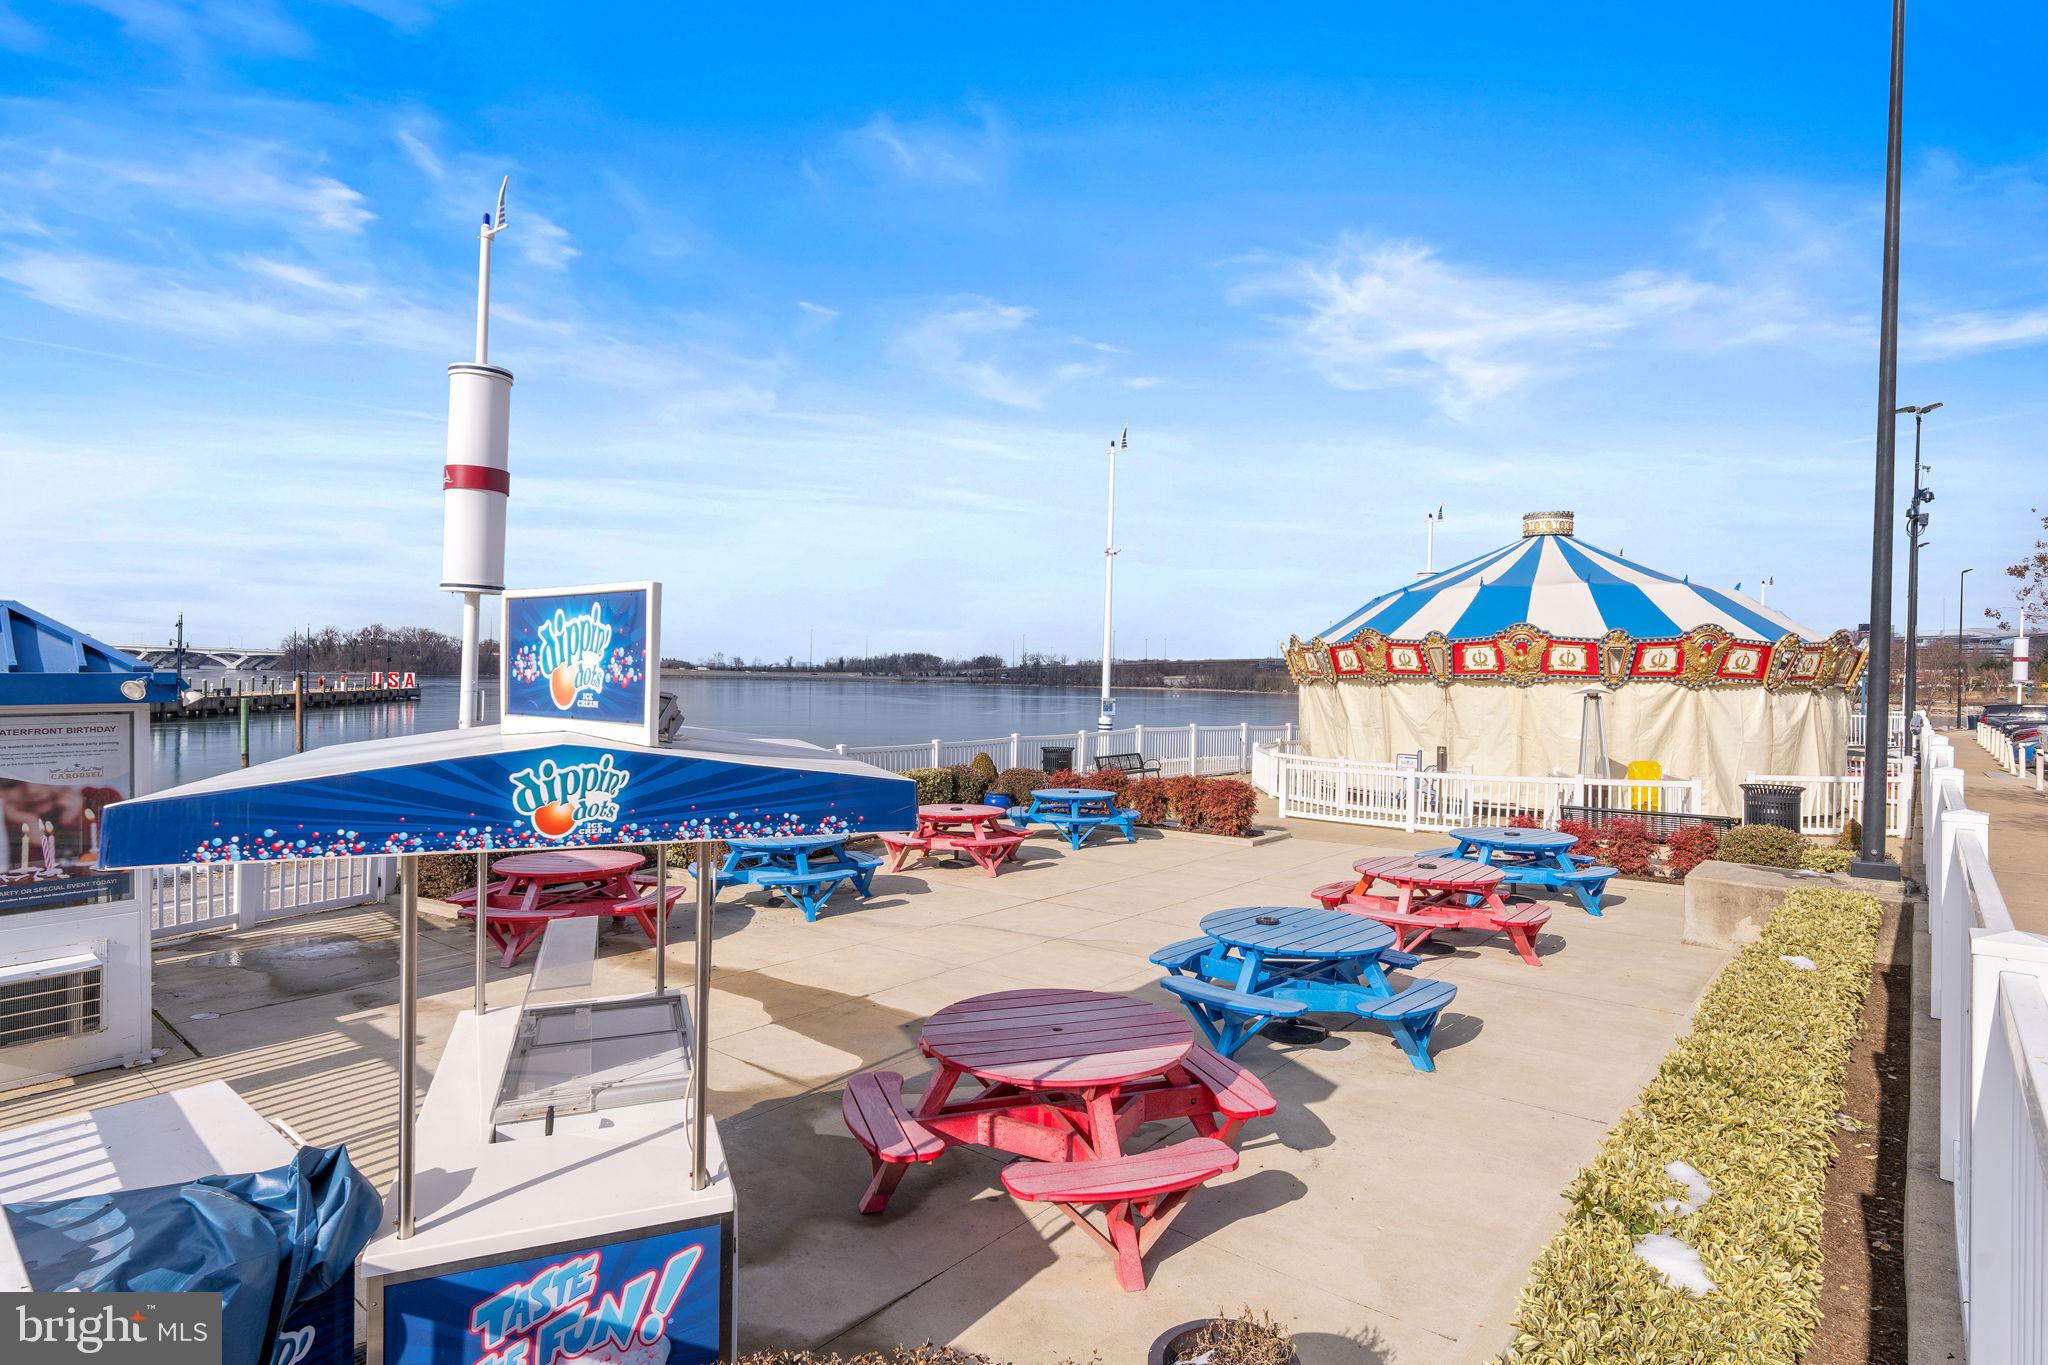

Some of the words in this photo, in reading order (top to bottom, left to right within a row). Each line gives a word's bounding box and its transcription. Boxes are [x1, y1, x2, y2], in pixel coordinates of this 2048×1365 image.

[372, 672, 415, 688] USA
[575, 661, 602, 690] dots
[577, 700, 599, 709] CREAM
[583, 693, 593, 701] ICE
[66, 725, 117, 734] BIRTHDAY
[51, 771, 103, 780] CAROUSEL
[511, 755, 629, 813] dippin'
[574, 800, 617, 821] dots
[33, 885, 65, 893] SPECIAL
[66, 881, 90, 889] EVENT
[92, 878, 118, 886] TODAY!
[470, 1252, 601, 1351] TASTE
[536, 1245, 704, 1365] FUN!
